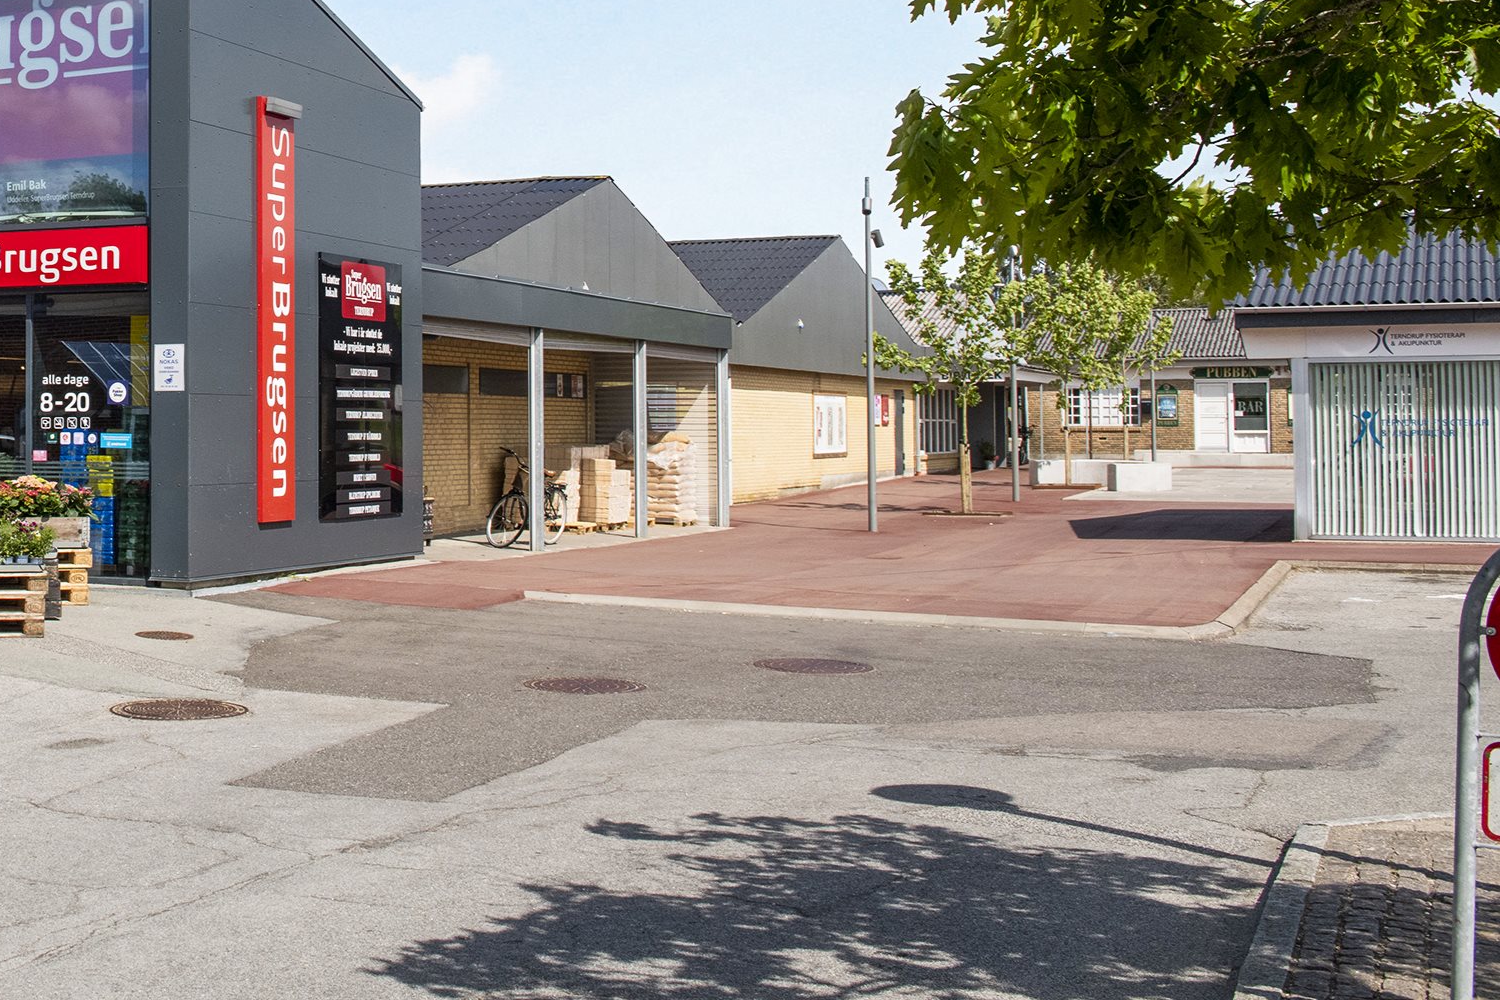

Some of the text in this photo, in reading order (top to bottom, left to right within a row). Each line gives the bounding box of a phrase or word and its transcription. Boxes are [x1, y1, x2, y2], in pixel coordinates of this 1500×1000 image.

[6, 179, 46, 192] Emil Bak
[345, 274, 382, 304] Brugsen
[1205, 366, 1258, 378] PUBBEN
[42, 374, 89, 387] alle dage
[1238, 400, 1263, 413] BAR
